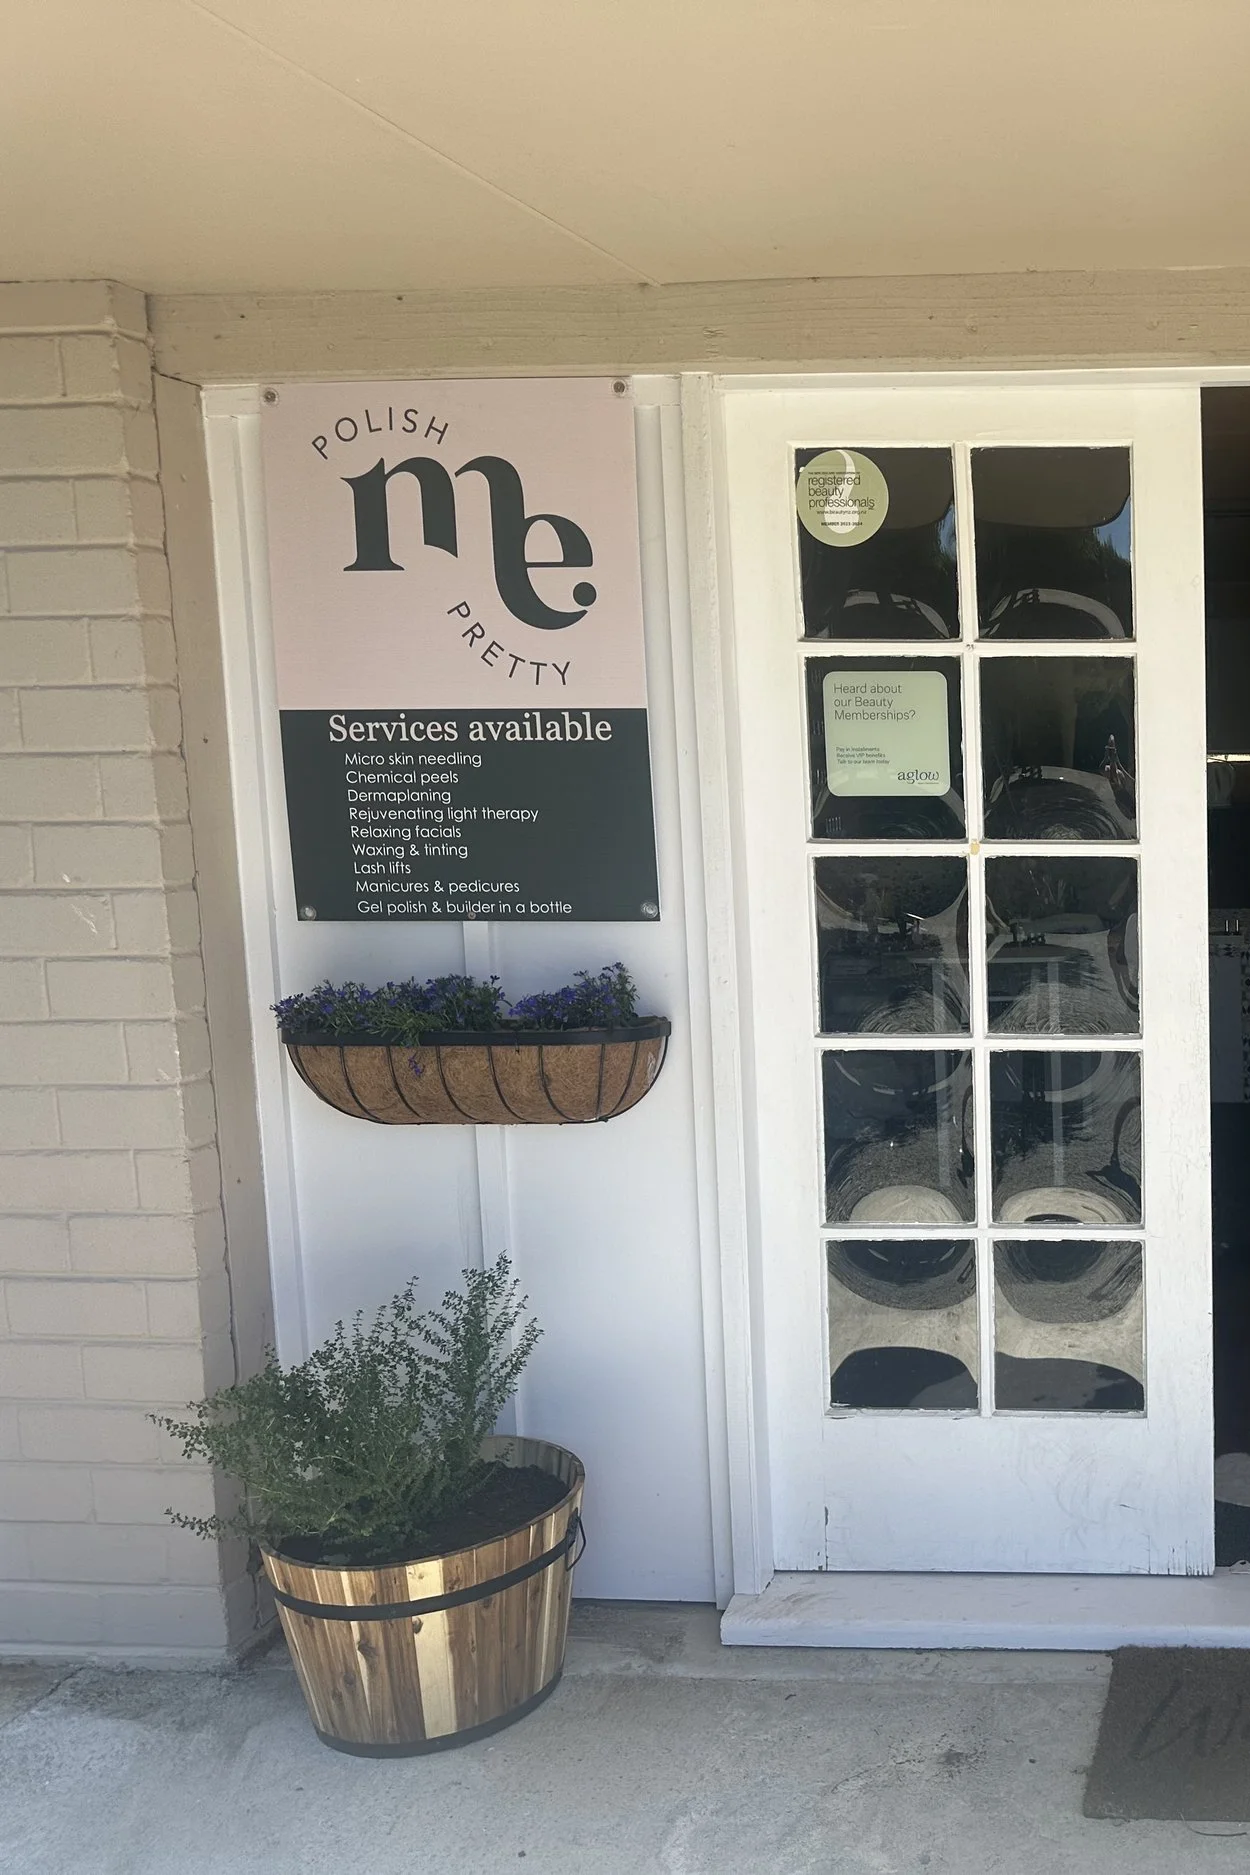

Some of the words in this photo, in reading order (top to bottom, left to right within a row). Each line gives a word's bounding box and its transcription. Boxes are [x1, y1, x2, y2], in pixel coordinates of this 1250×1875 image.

[312, 407, 449, 460] POLISH
[808, 474, 861, 488] registered
[808, 486, 844, 499] beauty
[808, 497, 875, 510] professionals
[447, 600, 571, 686] PRETTY
[834, 683, 867, 694] Heard
[870, 683, 902, 694] about
[834, 699, 851, 707] our
[855, 696, 893, 709] Beauty
[834, 709, 916, 722] Memberships?
[329, 713, 459, 742] Services
[469, 711, 613, 742] available
[344, 751, 385, 766] Micro
[388, 751, 414, 766] skin
[418, 751, 482, 768] needling
[346, 770, 417, 784] Chemical
[420, 770, 459, 786] peels
[897, 769, 940, 785] aglow
[347, 788, 451, 804] Dermaplaning
[349, 807, 444, 823] Rejuvenating
[447, 807, 478, 822] light
[481, 807, 539, 822] therapy
[350, 825, 411, 841] Relaxing
[415, 825, 462, 838] facials
[352, 843, 405, 859] Waxing
[409, 843, 420, 856] &
[424, 843, 468, 859] tinting
[353, 862, 386, 875] Lash
[389, 861, 412, 875] lifts
[355, 880, 430, 893] Manicures
[433, 880, 445, 893] &
[449, 880, 520, 895] pedicures
[357, 901, 383, 914] Gel
[387, 901, 427, 916] polish
[431, 901, 443, 914] &
[446, 900, 496, 914] builder
[499, 900, 512, 914] in
[515, 904, 526, 914] a
[530, 900, 573, 914] bottle
